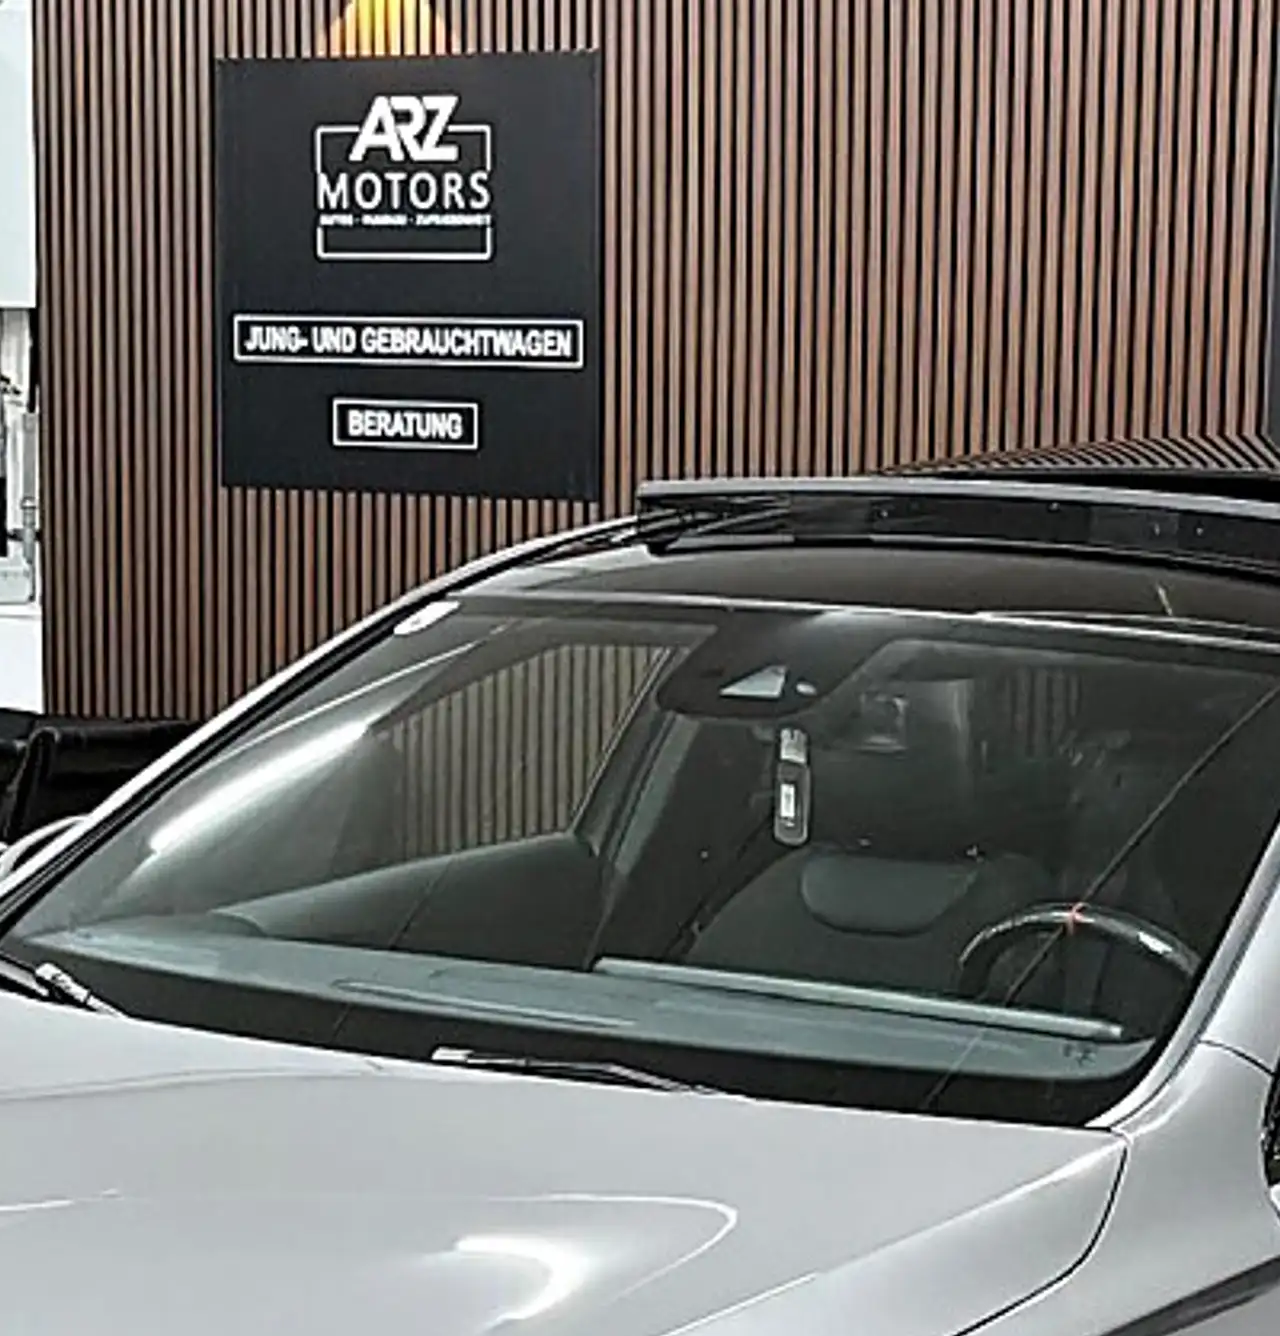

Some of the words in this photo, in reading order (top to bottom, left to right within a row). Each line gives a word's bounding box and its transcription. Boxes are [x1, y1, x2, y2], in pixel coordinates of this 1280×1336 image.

[349, 95, 459, 161] ARZ
[318, 171, 491, 209] MOTORS
[244, 326, 308, 352] JUNG-
[313, 328, 356, 354] UND
[361, 327, 572, 358] GEBRAUCHTWAGEN
[347, 410, 463, 438] BERATUNG
